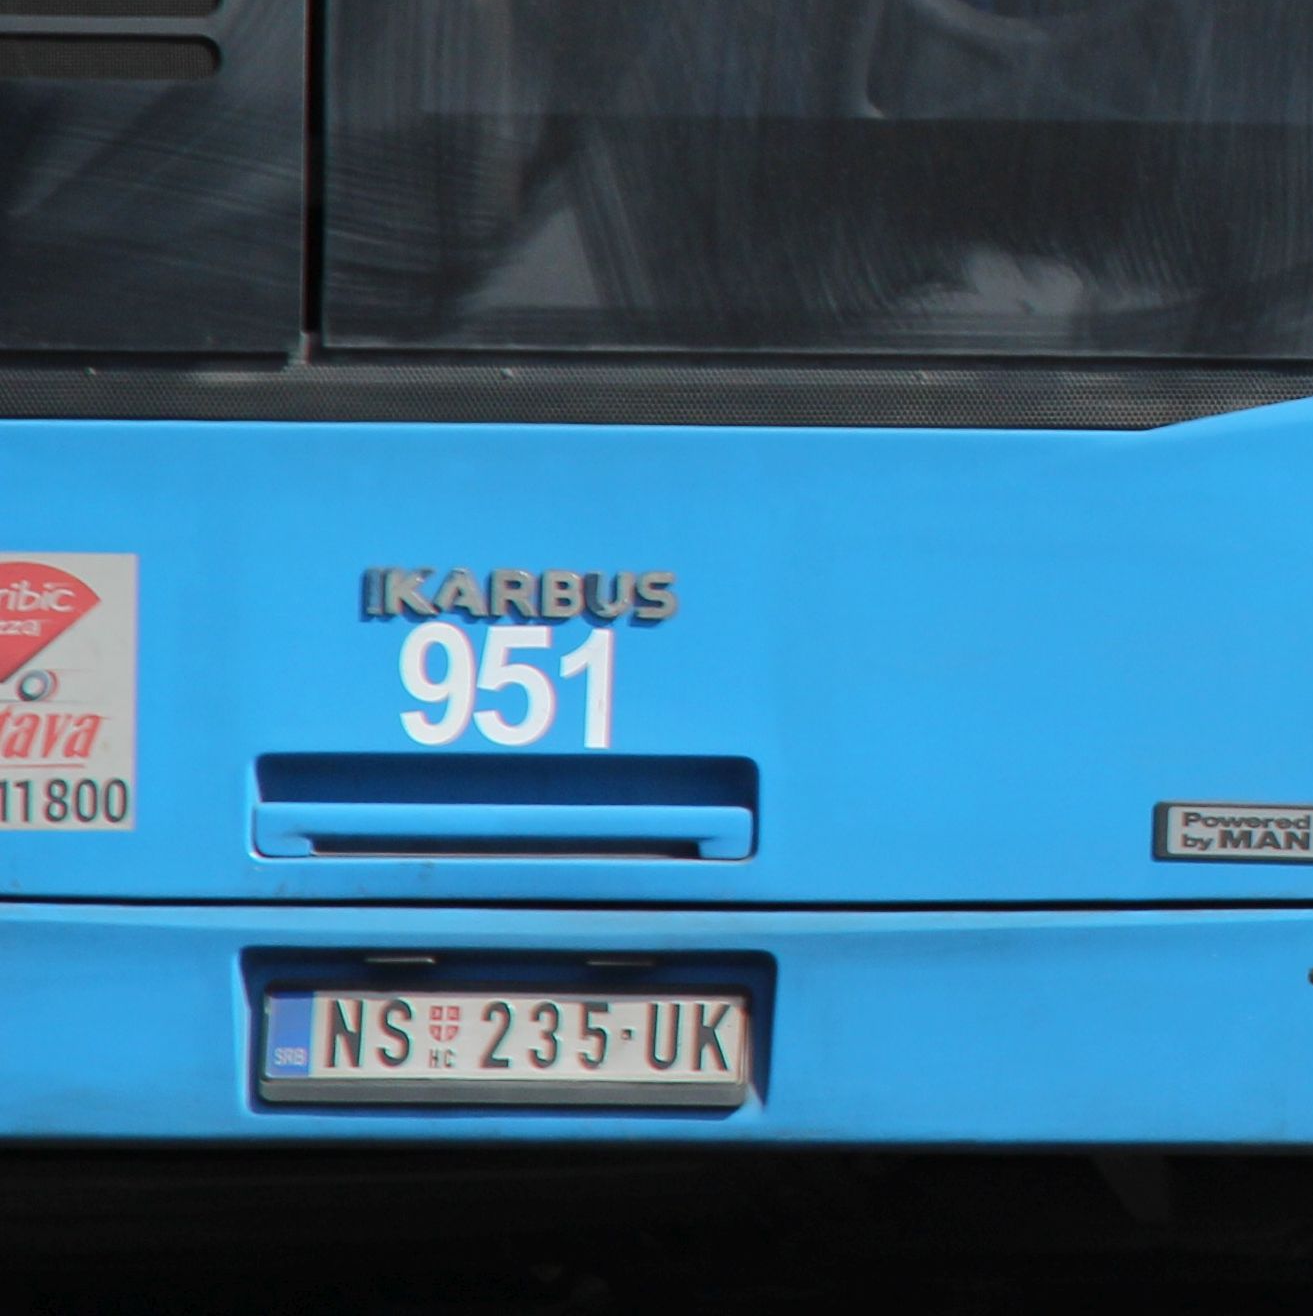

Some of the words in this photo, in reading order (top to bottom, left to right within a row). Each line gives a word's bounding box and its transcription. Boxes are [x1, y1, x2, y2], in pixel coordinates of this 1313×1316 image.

[362, 567, 677, 622] IKARBUS
[399, 621, 613, 749] 951
[1182, 811, 1311, 830] Powered
[1182, 833, 1213, 851] by
[1217, 830, 1311, 851] MAN
[326, 999, 413, 1068] NS
[275, 1047, 307, 1067] SRB
